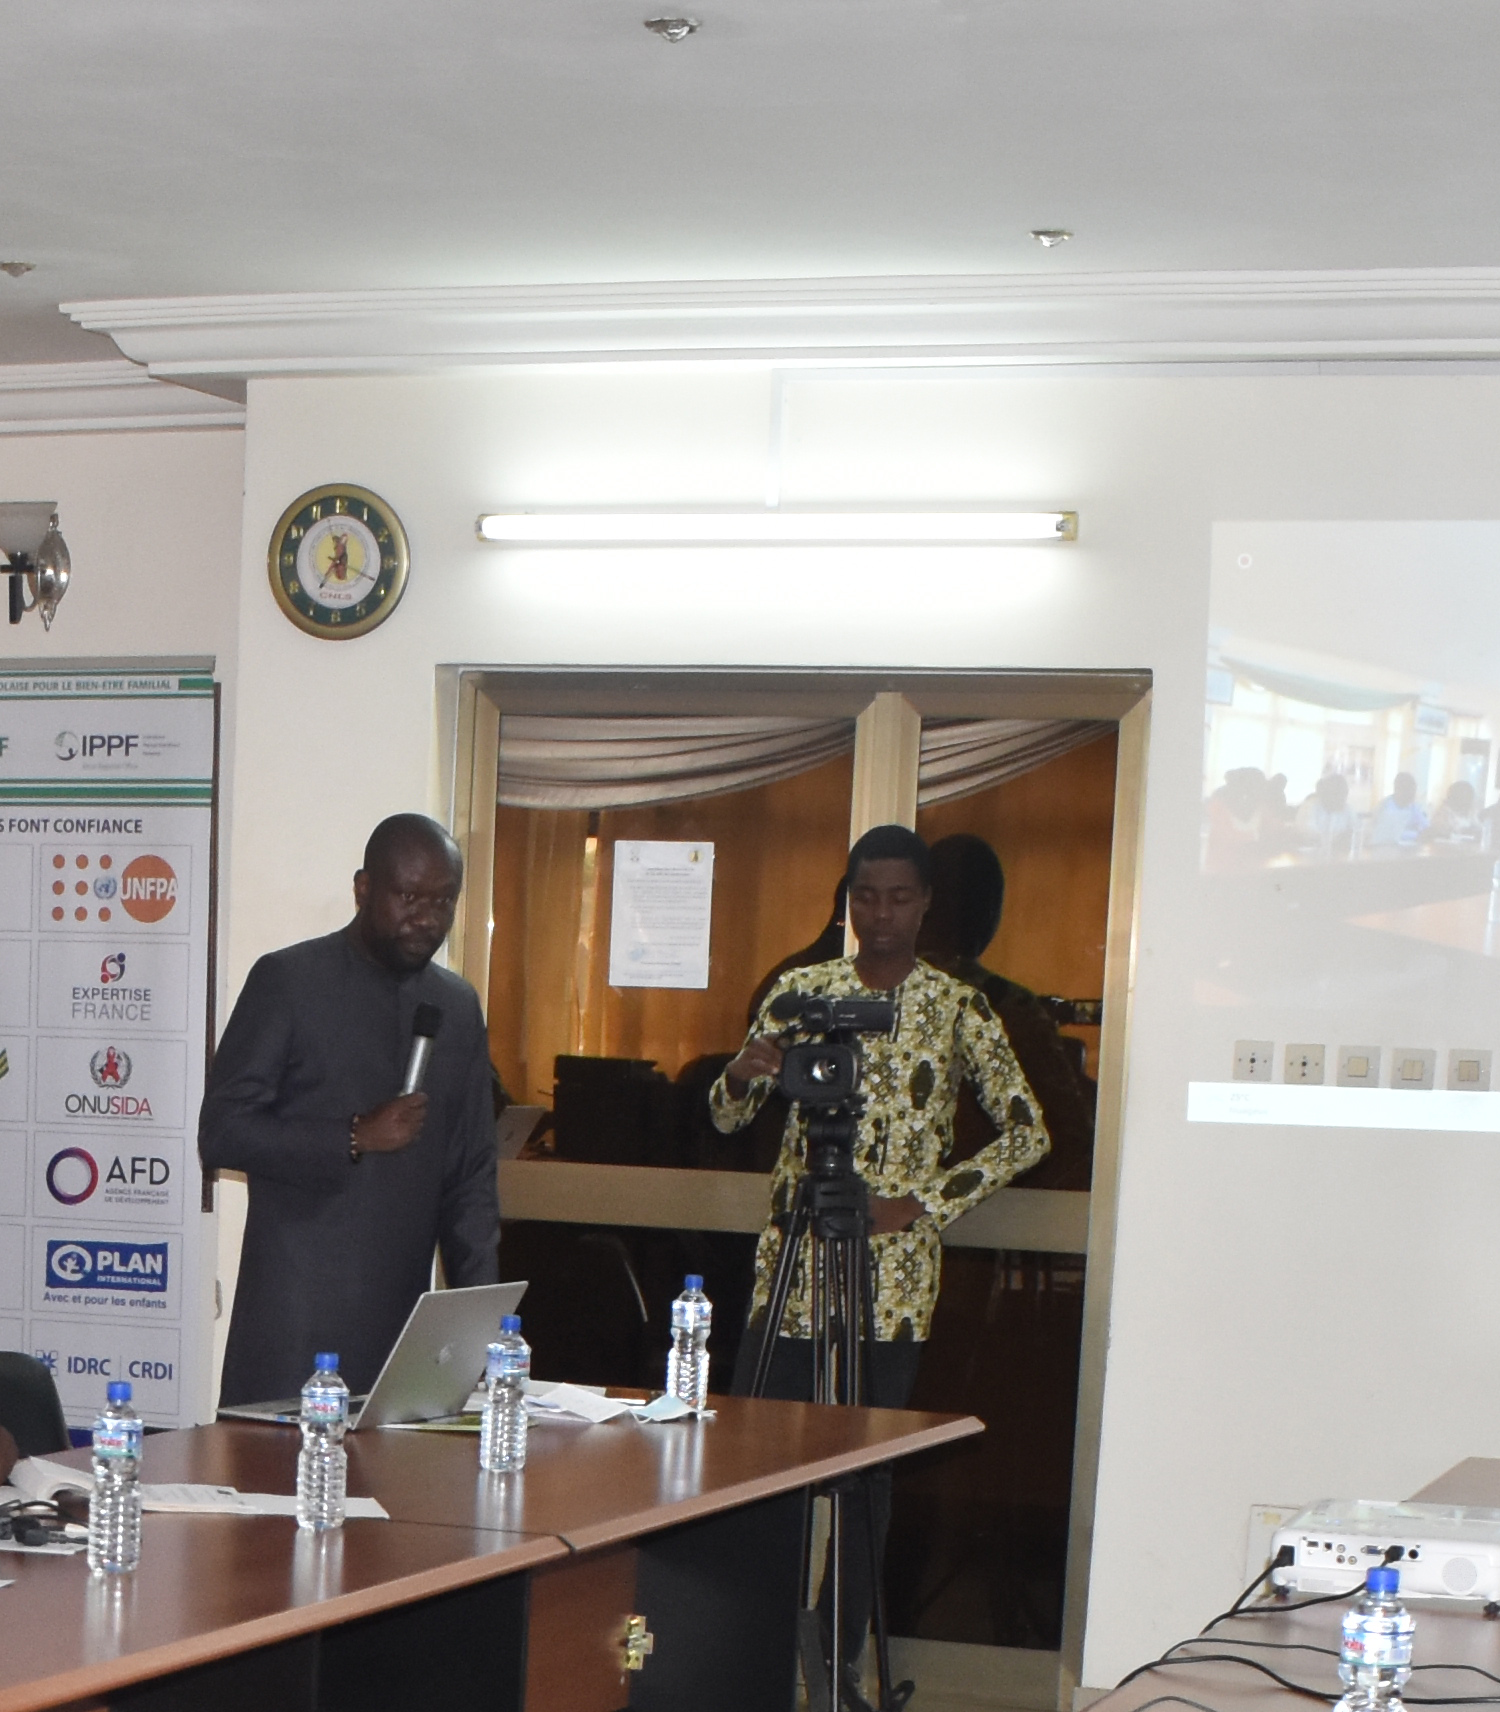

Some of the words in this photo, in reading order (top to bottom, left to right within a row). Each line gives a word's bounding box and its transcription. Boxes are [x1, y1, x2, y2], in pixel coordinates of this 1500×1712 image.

[33, 681, 59, 691] POUR
[62, 681, 72, 691] LE
[127, 680, 172, 690] FAMILIAL
[81, 735, 139, 757] IPPF
[8, 819, 50, 833] FONT
[53, 818, 143, 834] CONFIANCE
[120, 877, 178, 901] UNFPA
[72, 987, 151, 1002] EXPERTISE
[71, 1004, 152, 1021] FRANCE
[65, 1094, 152, 1116] ONUSIDA
[106, 1156, 170, 1185] AFD
[97, 1251, 163, 1274] PLAN
[97, 1275, 161, 1285] INTERNATIONAL
[44, 1292, 69, 1302] Avec
[72, 1294, 81, 1303] et
[84, 1296, 108, 1305] pour
[111, 1296, 126, 1306] les
[129, 1298, 166, 1308] enfants
[67, 1357, 111, 1377] IDRC
[129, 1360, 173, 1380] CRDI
